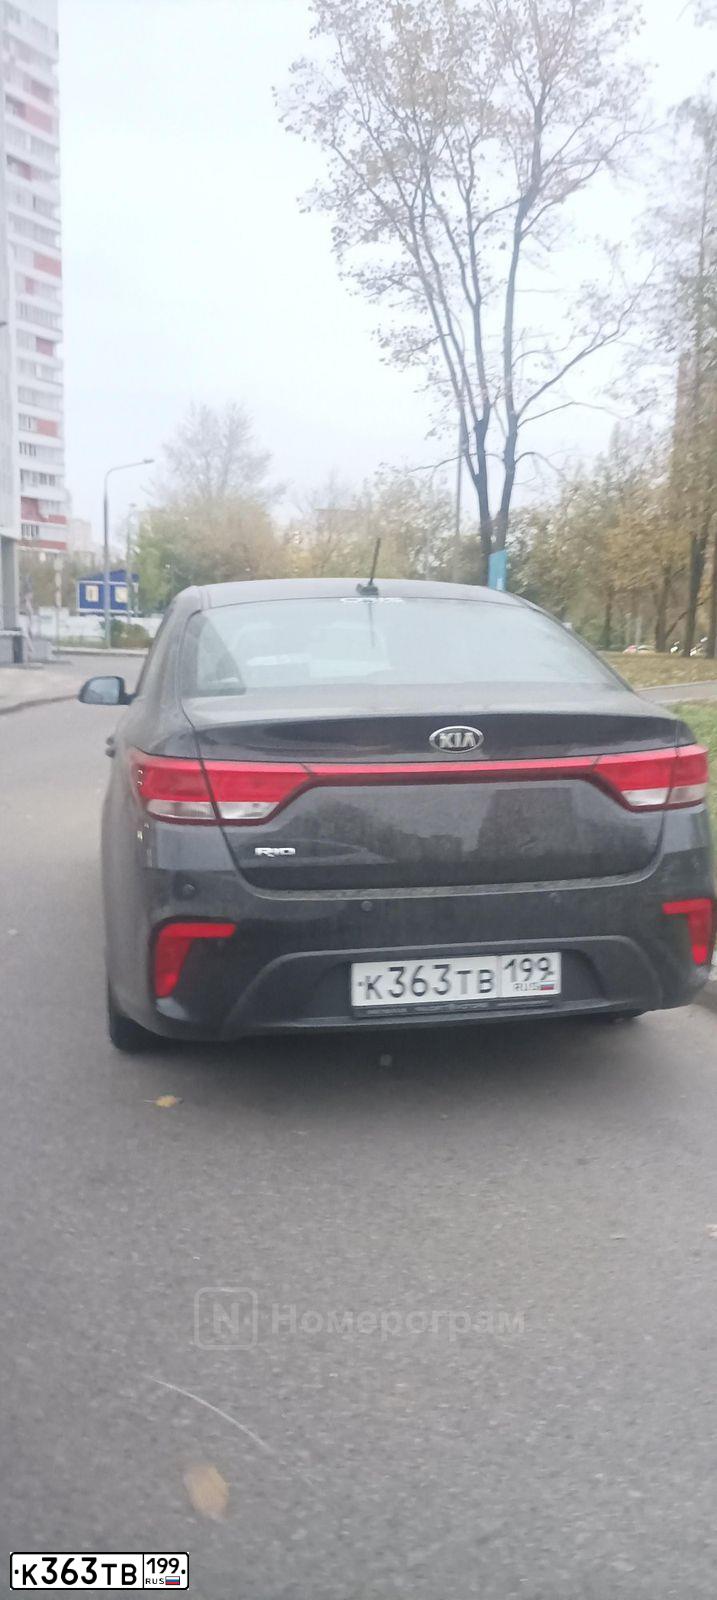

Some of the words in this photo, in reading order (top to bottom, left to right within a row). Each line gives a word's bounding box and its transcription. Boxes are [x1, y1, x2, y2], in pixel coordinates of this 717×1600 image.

[439, 732, 477, 748] KIA
[254, 847, 296, 857] RIO
[504, 956, 551, 982] 199
